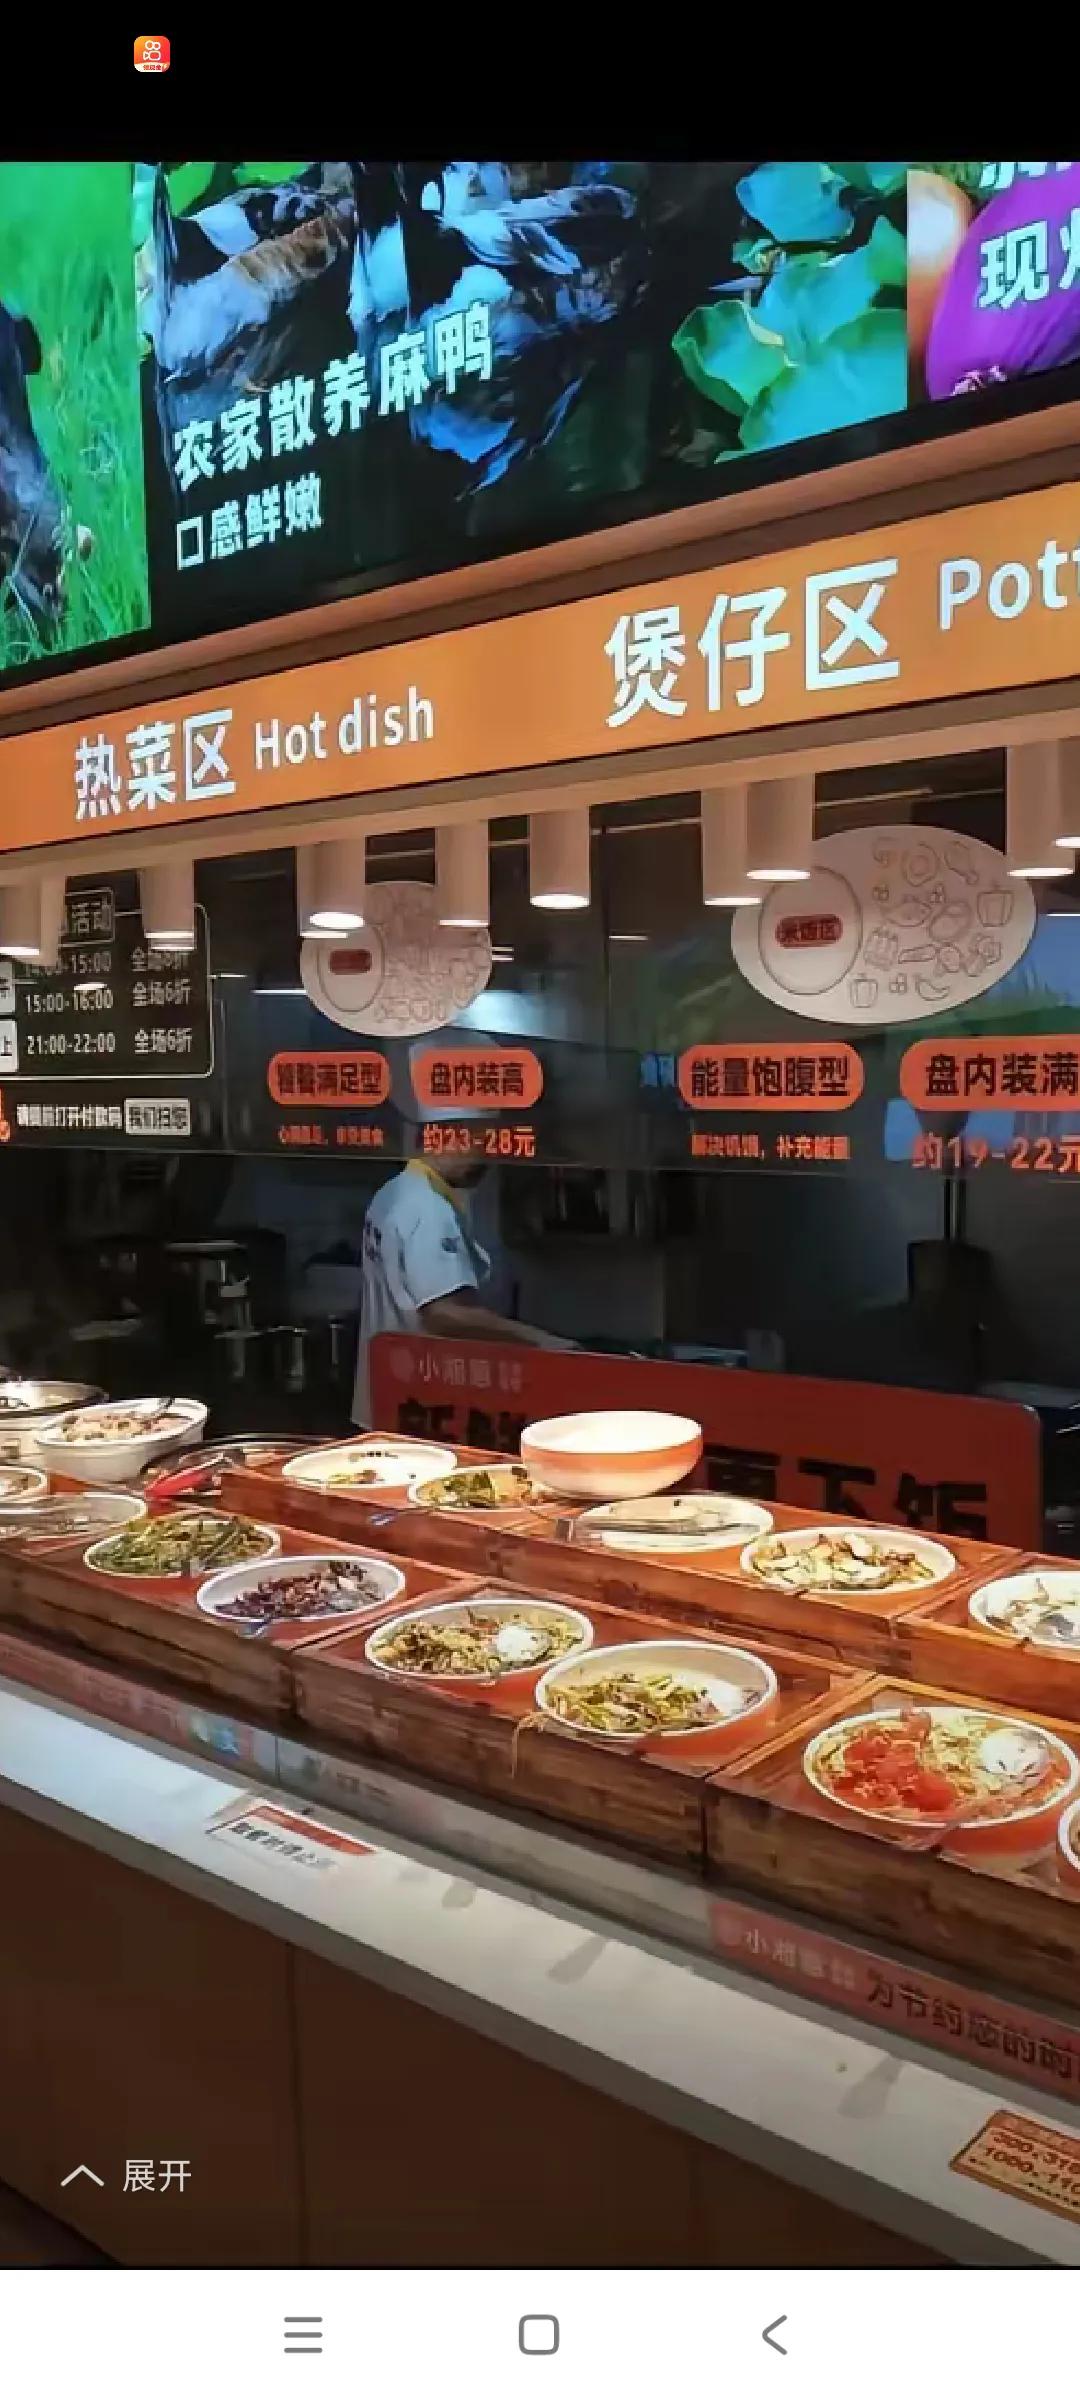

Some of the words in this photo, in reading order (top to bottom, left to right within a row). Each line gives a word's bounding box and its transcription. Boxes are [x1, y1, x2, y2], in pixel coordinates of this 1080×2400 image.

[174, 299, 491, 491] 农家散养麻鸭
[176, 471, 322, 569] 口感鲜嫩
[604, 558, 899, 727] 煲仔区
[941, 540, 1080, 630] Pot
[75, 709, 236, 822] 热菜区
[255, 712, 328, 770] Hot
[338, 685, 433, 755] dish
[26, 1031, 117, 1056] 21:00-22:00
[430, 1063, 525, 1097] 盘内装高
[926, 1053, 1079, 1097] 盘内装满
[423, 1123, 536, 1157] 约23-28元
[868, 1969, 1080, 2082] 为节约您的时
